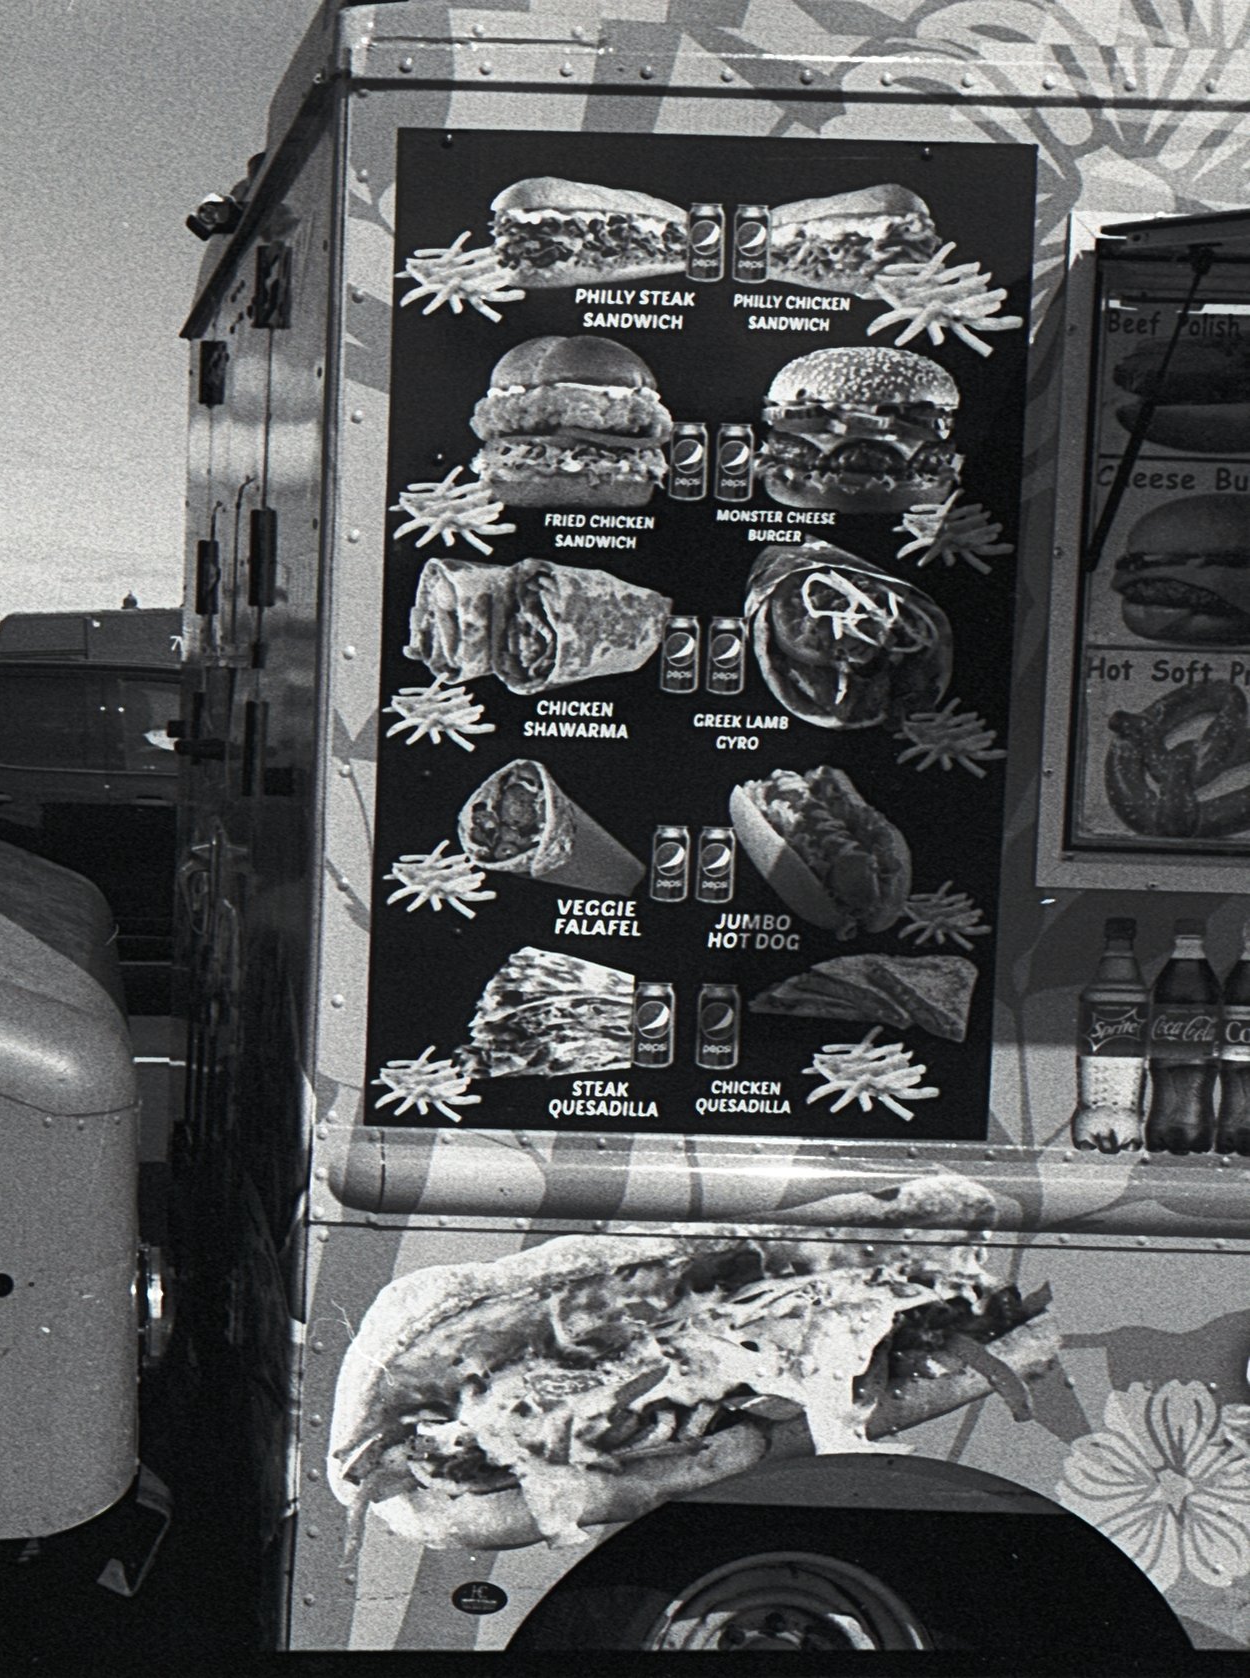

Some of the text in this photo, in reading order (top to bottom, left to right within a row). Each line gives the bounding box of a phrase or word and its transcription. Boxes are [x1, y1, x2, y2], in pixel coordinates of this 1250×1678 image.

[574, 288, 696, 307] PHILLY STEAK
[733, 293, 851, 311] PHILLY CHICKEN
[582, 311, 684, 330] SANDWICH
[747, 315, 830, 332] SANDWICH
[1107, 310, 1161, 336] Beef
[1097, 464, 1193, 491] Ceese
[544, 513, 655, 530] FRIED CHICKEN
[716, 509, 836, 525] MONSTER CHEESE
[554, 533, 637, 549] SANDWICH
[747, 528, 802, 543] BURGER
[1087, 655, 1134, 681] Hot
[1151, 658, 1213, 685] Soft
[536, 699, 614, 718] CHICKEN
[523, 720, 629, 739] SHAWARMA
[693, 713, 790, 730] GREEK LAMB
[715, 735, 760, 751] GYRO
[557, 898, 637, 917] VEGGIE
[554, 918, 642, 937] FALAFEL
[714, 912, 791, 931] JUMBO
[707, 931, 800, 950] HOT DOG
[1091, 1018, 1140, 1040] Sprite
[571, 1080, 629, 1098] STEAK
[710, 1079, 781, 1096] CHICKEN
[548, 1098, 659, 1119] QUESADILLA
[695, 1097, 791, 1116] QUESADILLA
